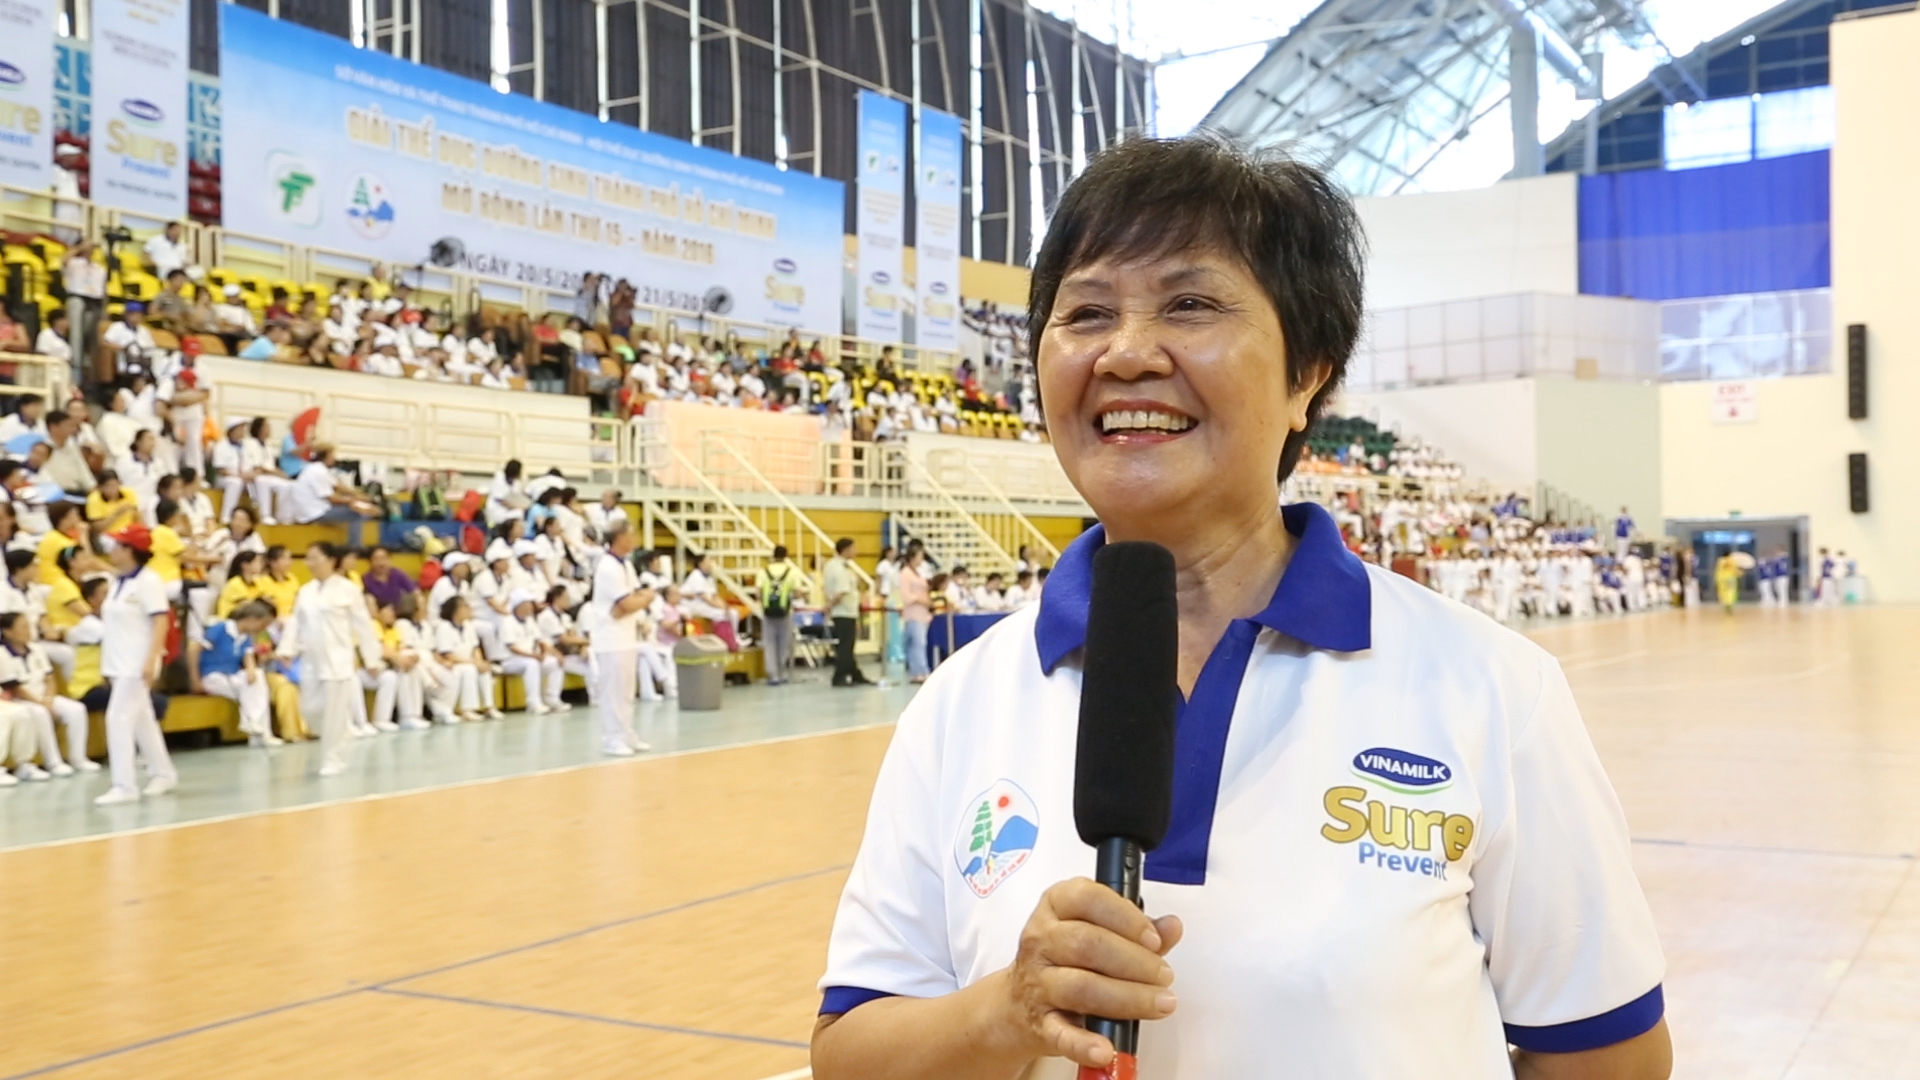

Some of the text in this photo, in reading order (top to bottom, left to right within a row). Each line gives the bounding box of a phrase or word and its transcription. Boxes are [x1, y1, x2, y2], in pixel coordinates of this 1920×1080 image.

[1359, 754, 1447, 780] VINAMILK
[1320, 786, 1474, 861] Sure
[1358, 842, 1448, 881] Prevent
